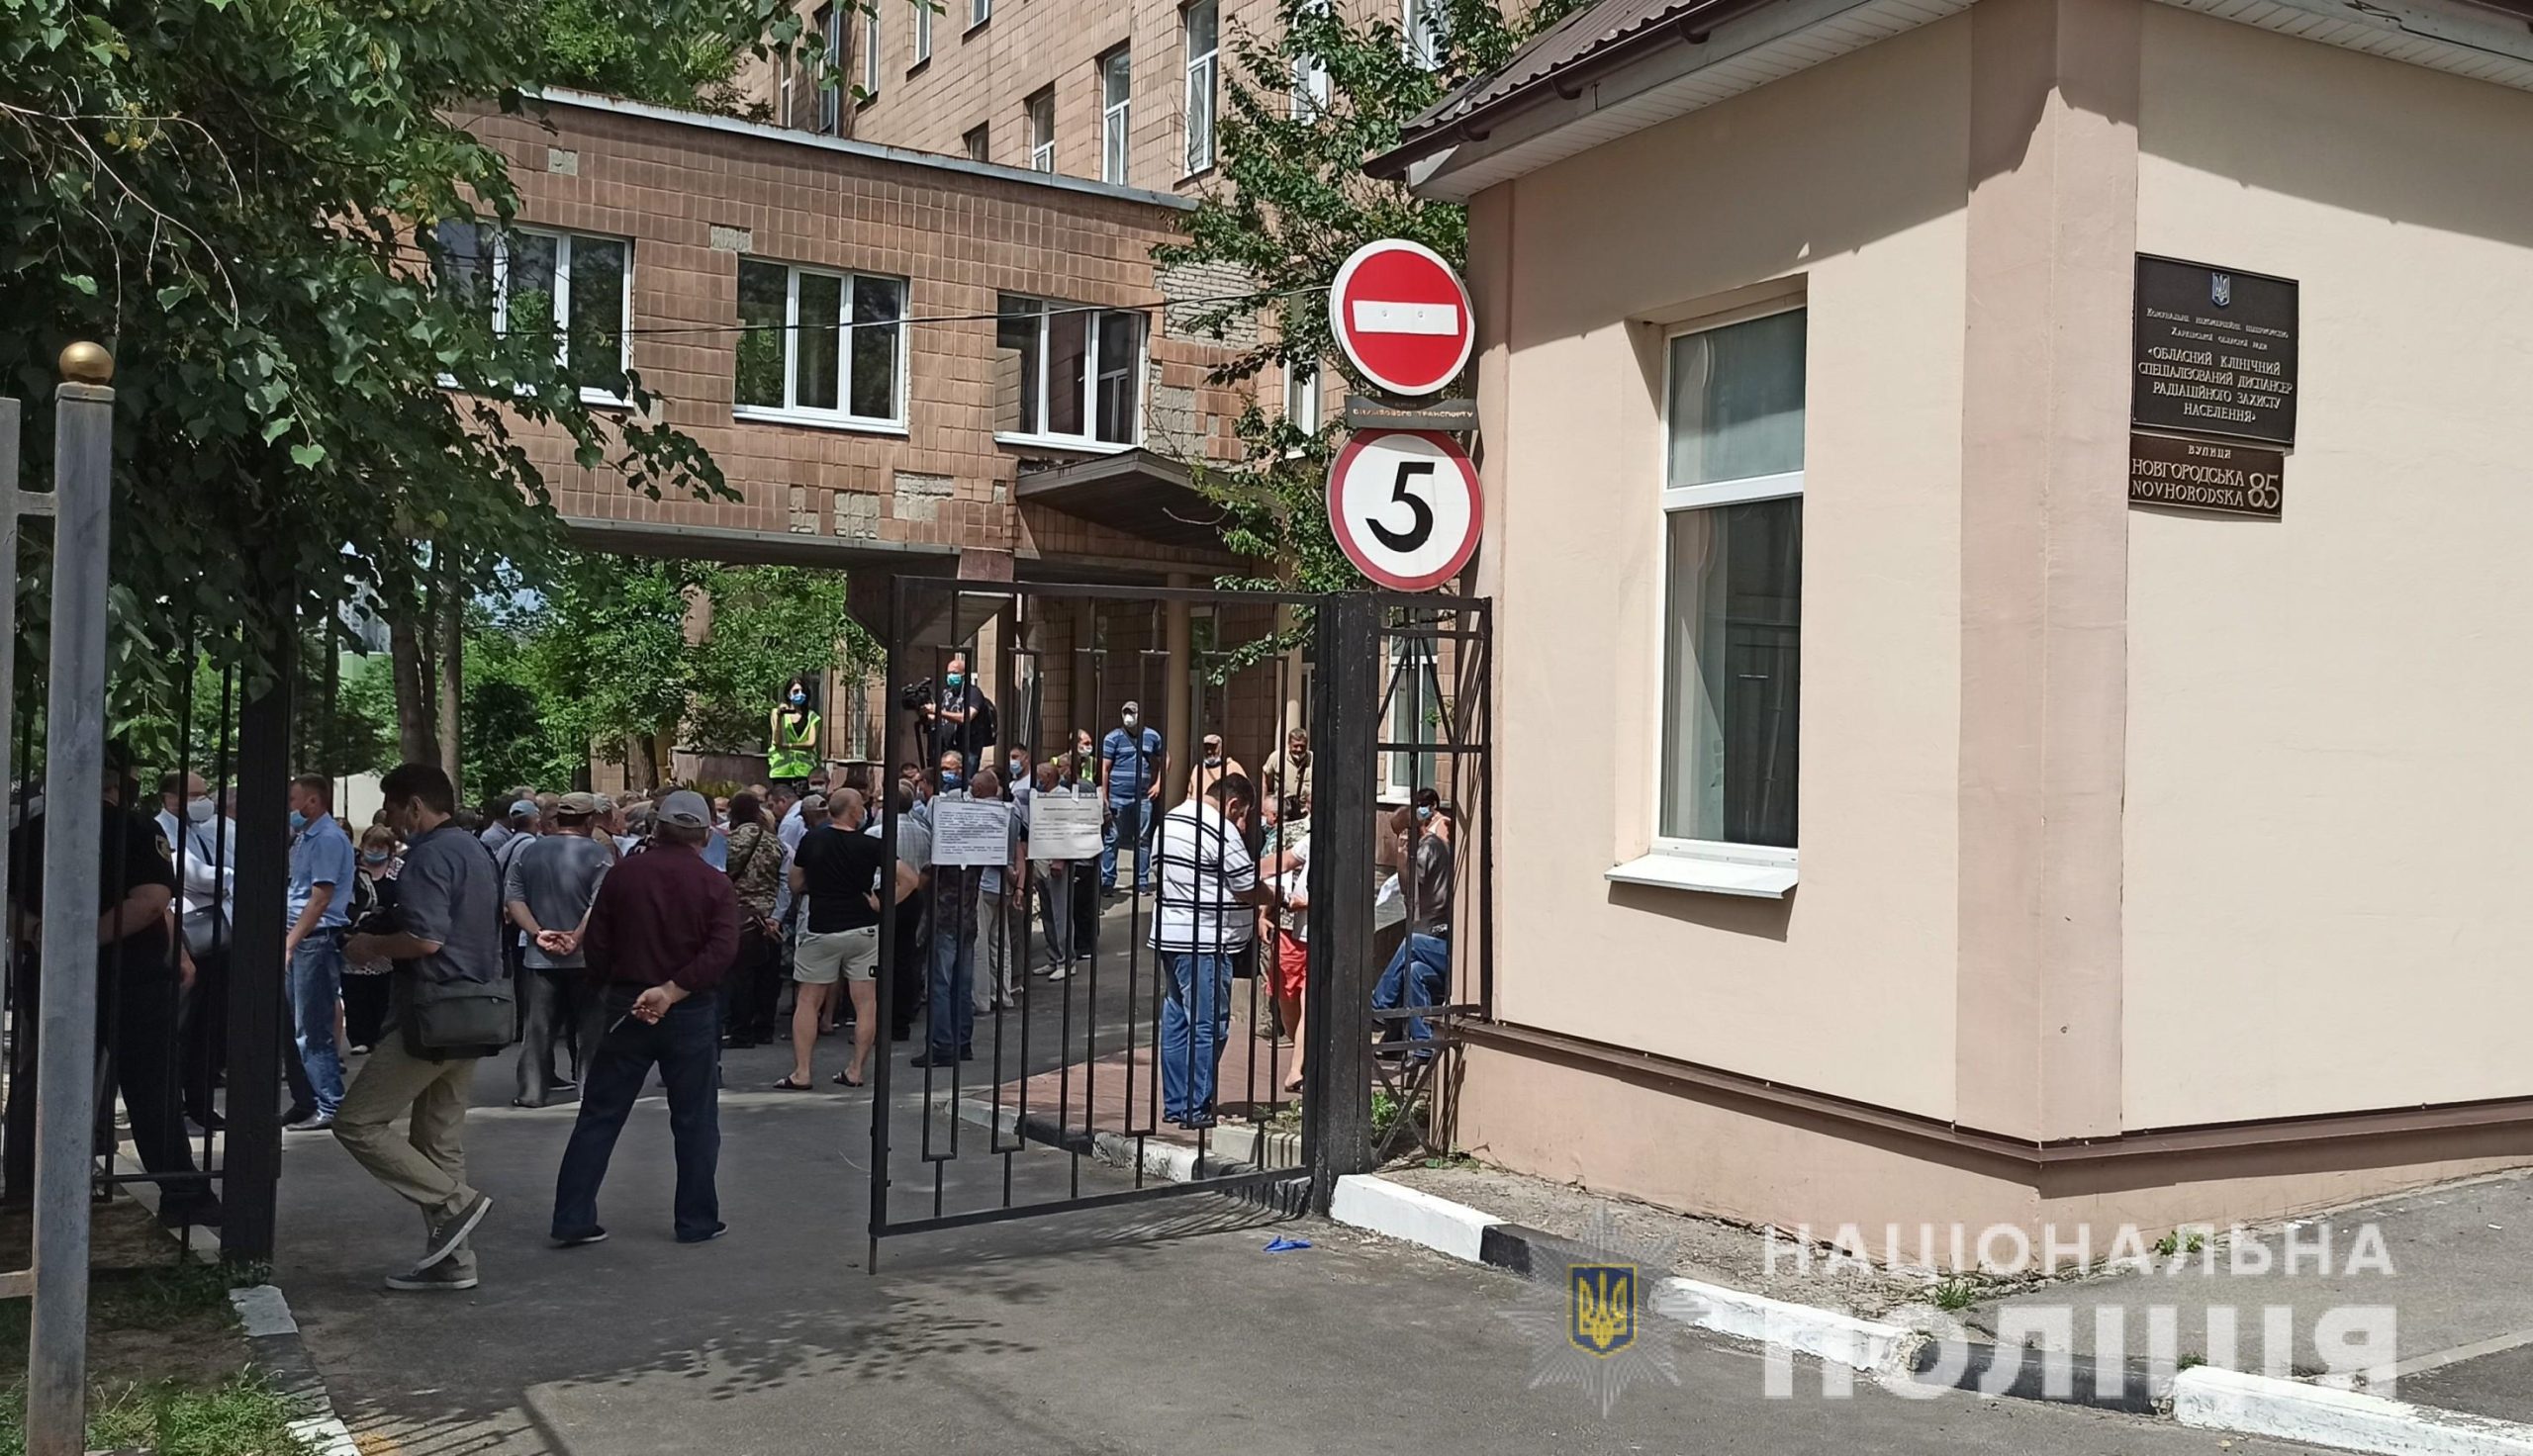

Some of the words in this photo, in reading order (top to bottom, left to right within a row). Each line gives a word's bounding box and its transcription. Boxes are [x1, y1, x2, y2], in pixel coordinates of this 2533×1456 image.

[2138, 362, 2233, 386] СПЕЦІАЛІЗОВАНИЙ
[2237, 375, 2294, 395] ДИСПАНСЕР
[2219, 355, 2281, 376] КЛІНІЧНИЙ
[2153, 382, 2232, 403] РАДІАЦІЙНОГО
[2237, 392, 2282, 409] ЗАХИСТУ
[2131, 458, 2245, 487] НОВГОРОДСЬКА
[2131, 480, 2244, 506] NOVHORODSKA
[2248, 473, 2280, 509] 85
[1365, 461, 1435, 553] 5
